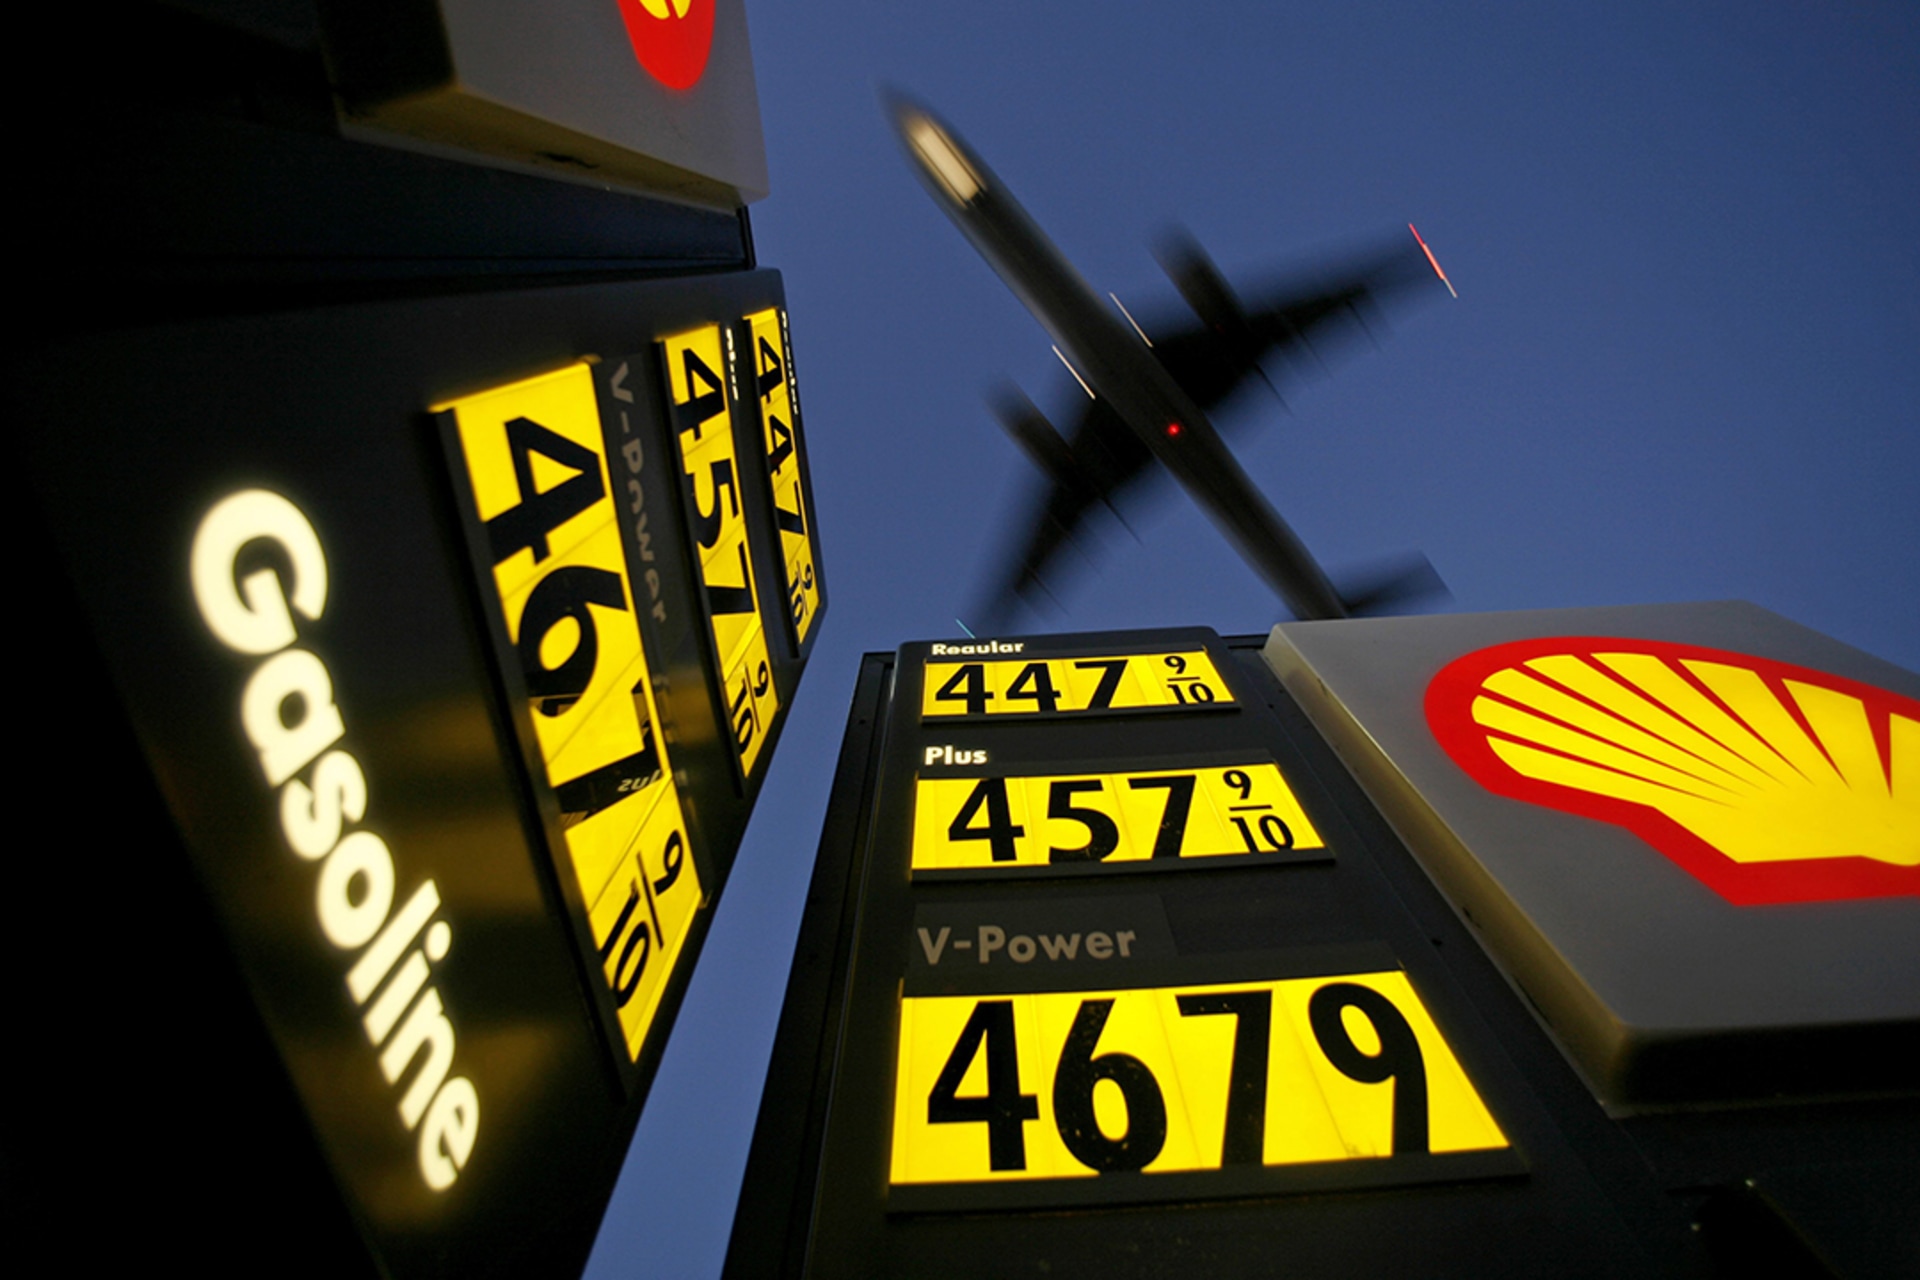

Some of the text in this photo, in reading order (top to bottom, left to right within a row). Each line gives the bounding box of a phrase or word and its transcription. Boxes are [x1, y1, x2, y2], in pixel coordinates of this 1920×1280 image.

[675, 348, 756, 616] 457
[758, 336, 805, 536] 447
[486, 416, 664, 828] 467
[935, 659, 1129, 714] 447
[923, 745, 988, 766] Plus
[947, 774, 1197, 864] 457
[190, 487, 479, 1192] Gasoline
[916, 925, 1137, 965] V-Power
